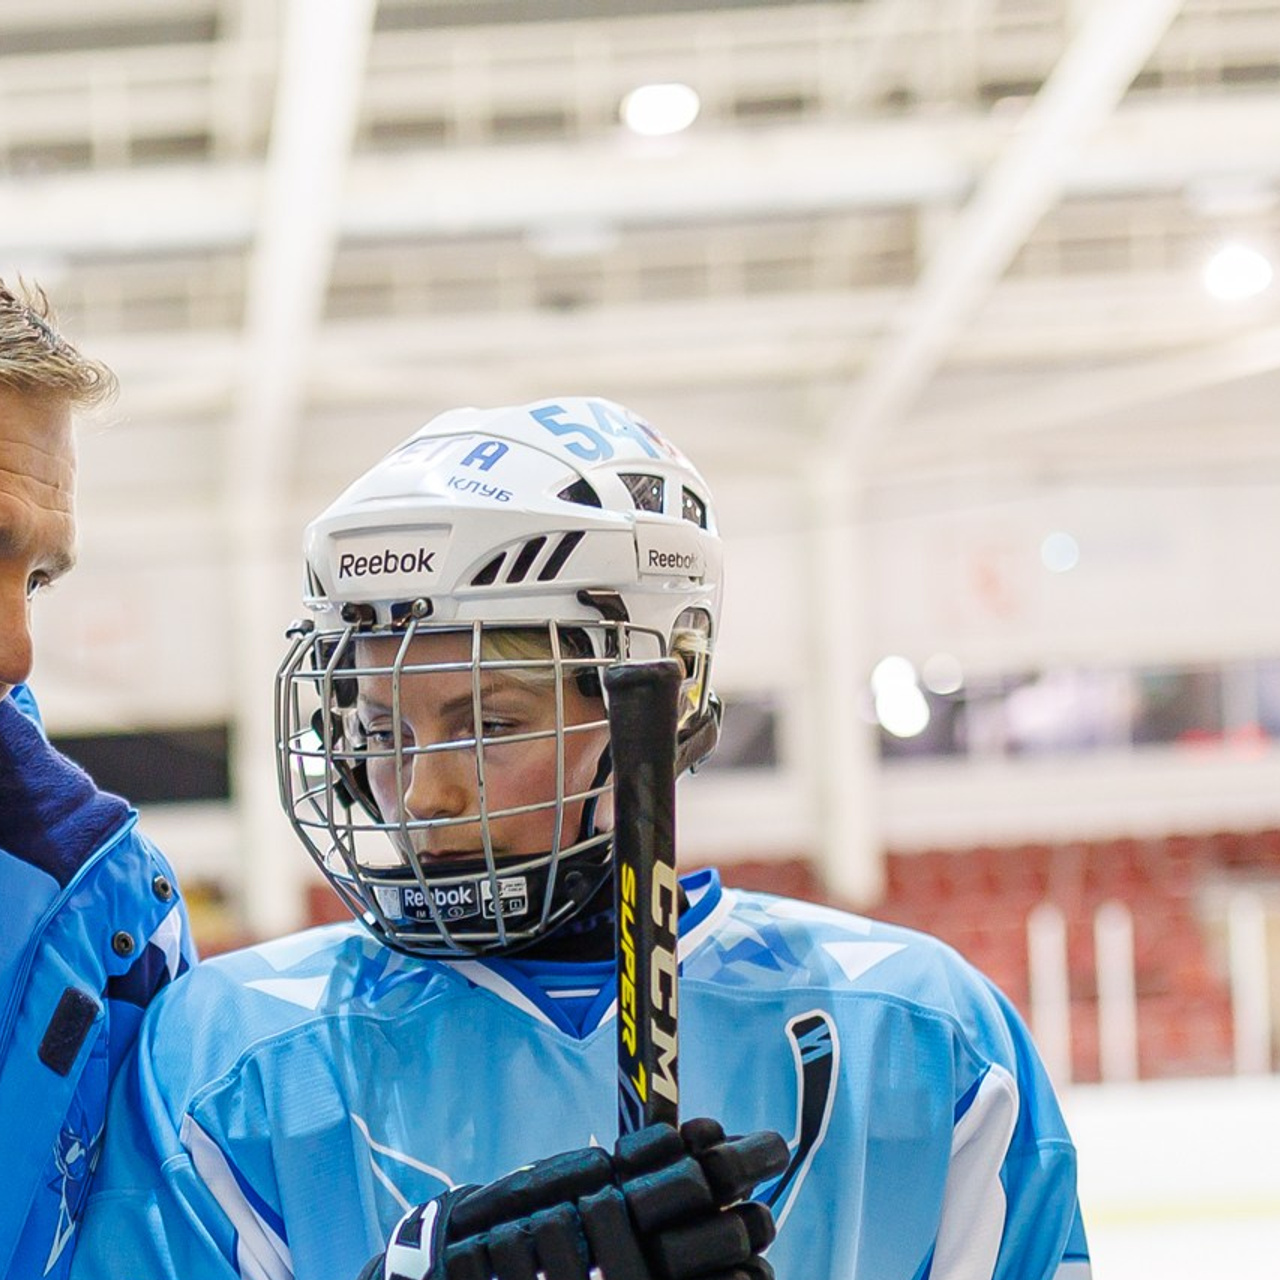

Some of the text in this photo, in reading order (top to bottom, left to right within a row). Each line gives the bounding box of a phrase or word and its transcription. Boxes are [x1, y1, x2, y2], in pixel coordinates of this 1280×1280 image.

[447, 475, 513, 503] КЛУБ
[338, 547, 436, 579] Reebok
[404, 886, 473, 908] Rebok
[621, 862, 637, 1057] SUPER
[650, 859, 678, 1105] CCM
